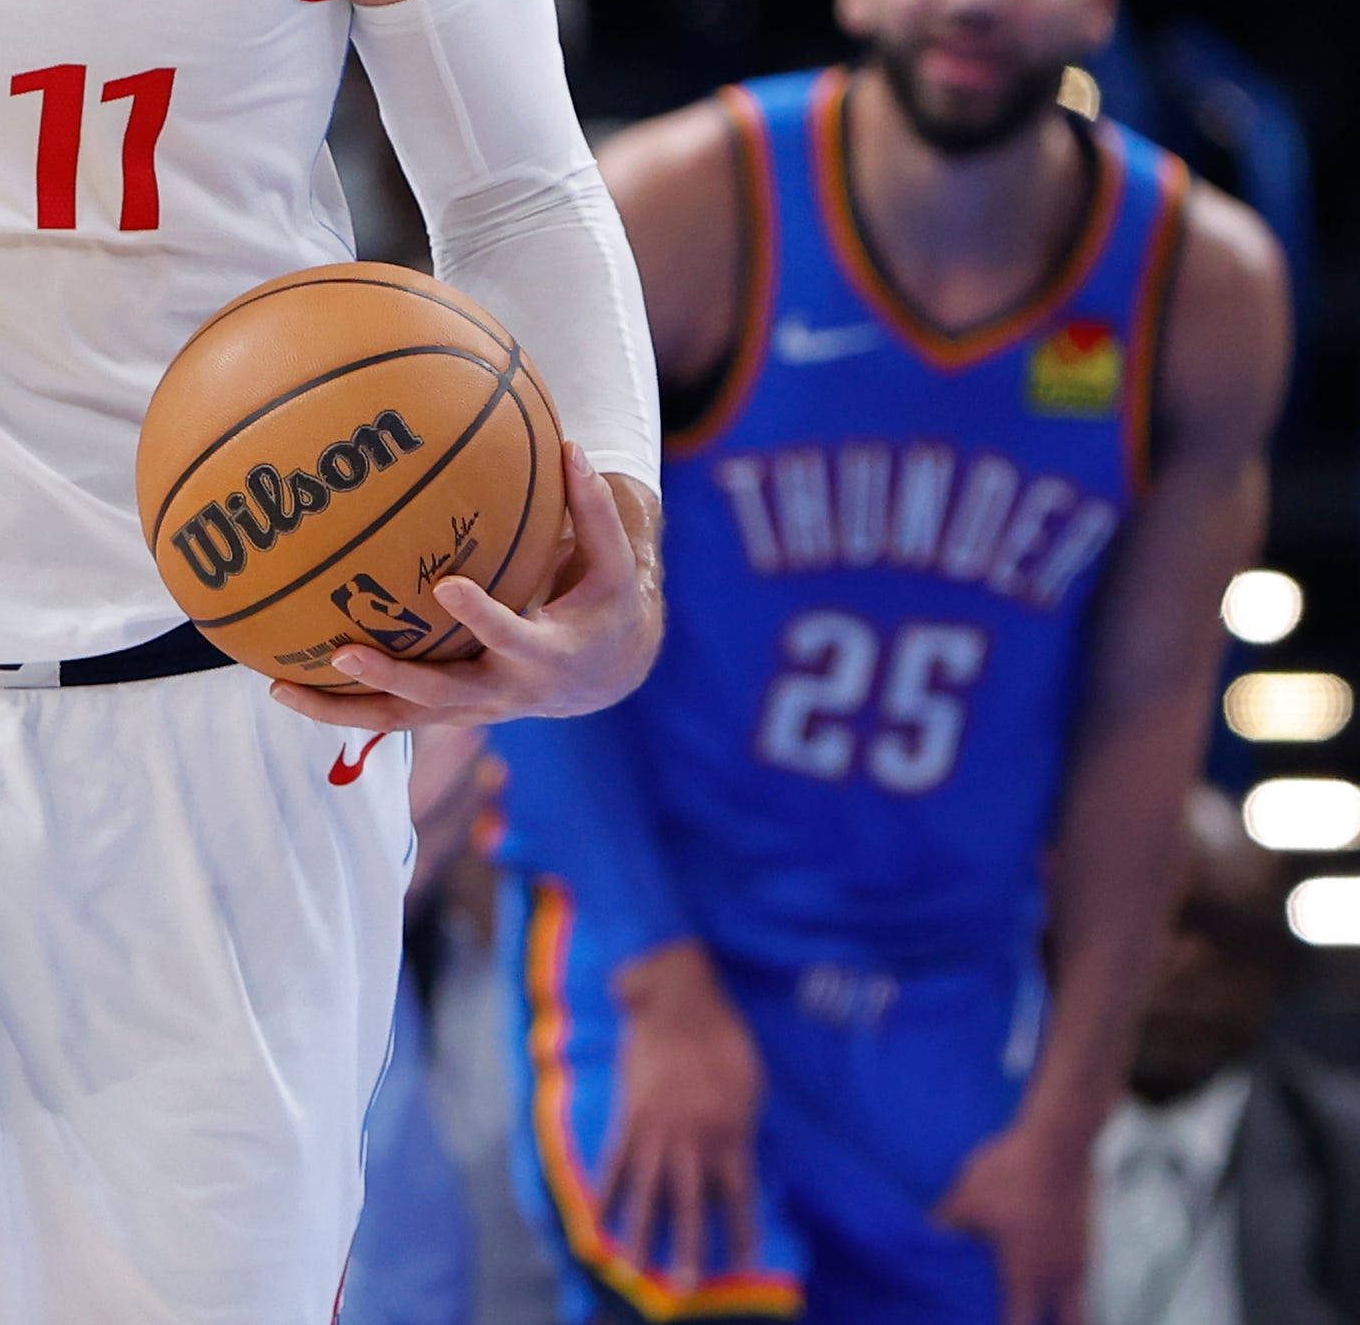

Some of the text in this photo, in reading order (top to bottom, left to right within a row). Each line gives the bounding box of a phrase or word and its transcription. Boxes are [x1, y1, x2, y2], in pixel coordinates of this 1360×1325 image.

[10, 64, 177, 231] 11
[170, 409, 425, 591] Wilson
[759, 607, 989, 794] 25
